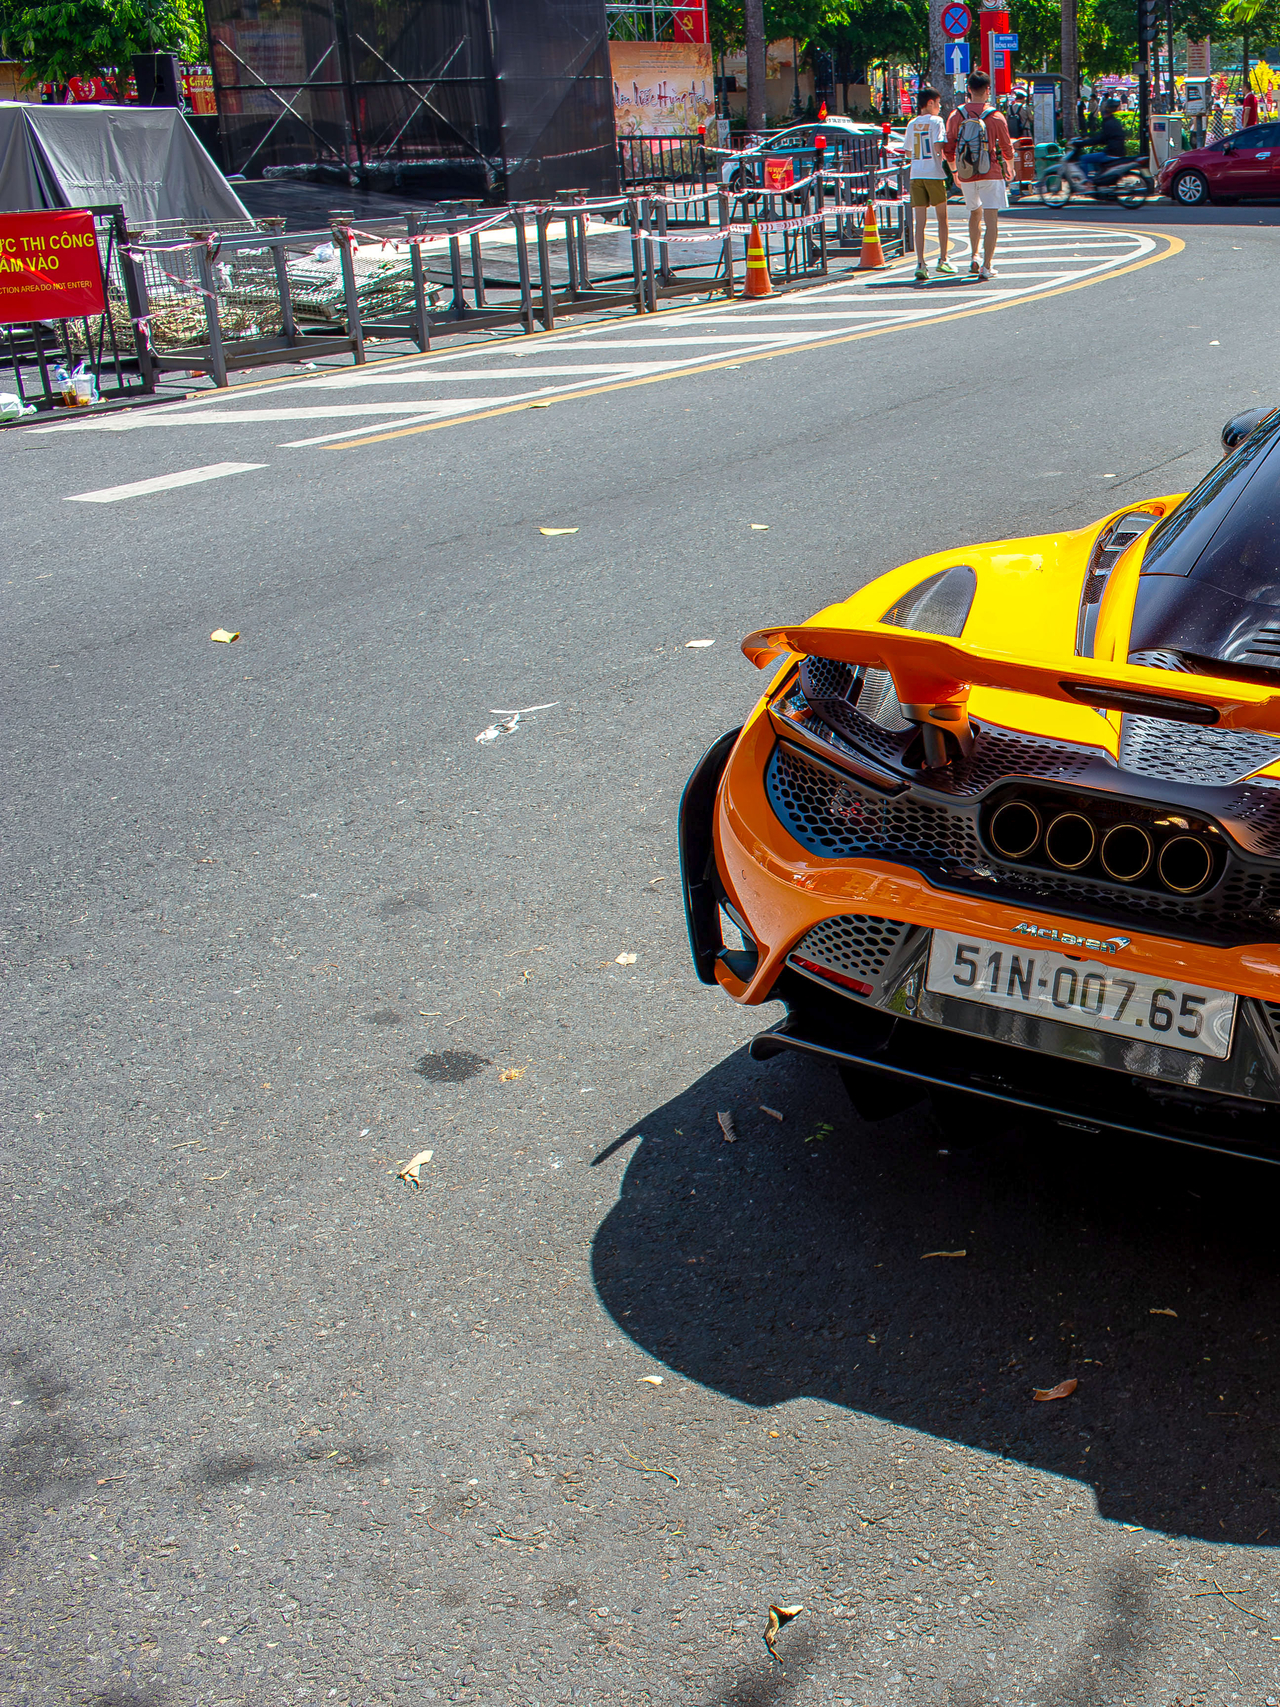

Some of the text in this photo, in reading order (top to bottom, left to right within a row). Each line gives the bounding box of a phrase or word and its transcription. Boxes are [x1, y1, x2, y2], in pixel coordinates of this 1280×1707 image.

[20, 236, 45, 252] THI
[50, 231, 95, 250] CÔNG
[26, 253, 59, 271] VÀO
[21, 284, 40, 293] AREA
[40, 283, 52, 291] DO
[53, 282, 66, 290] NOT
[67, 280, 93, 289] ENTER)
[1010, 922, 1116, 955] McLaren
